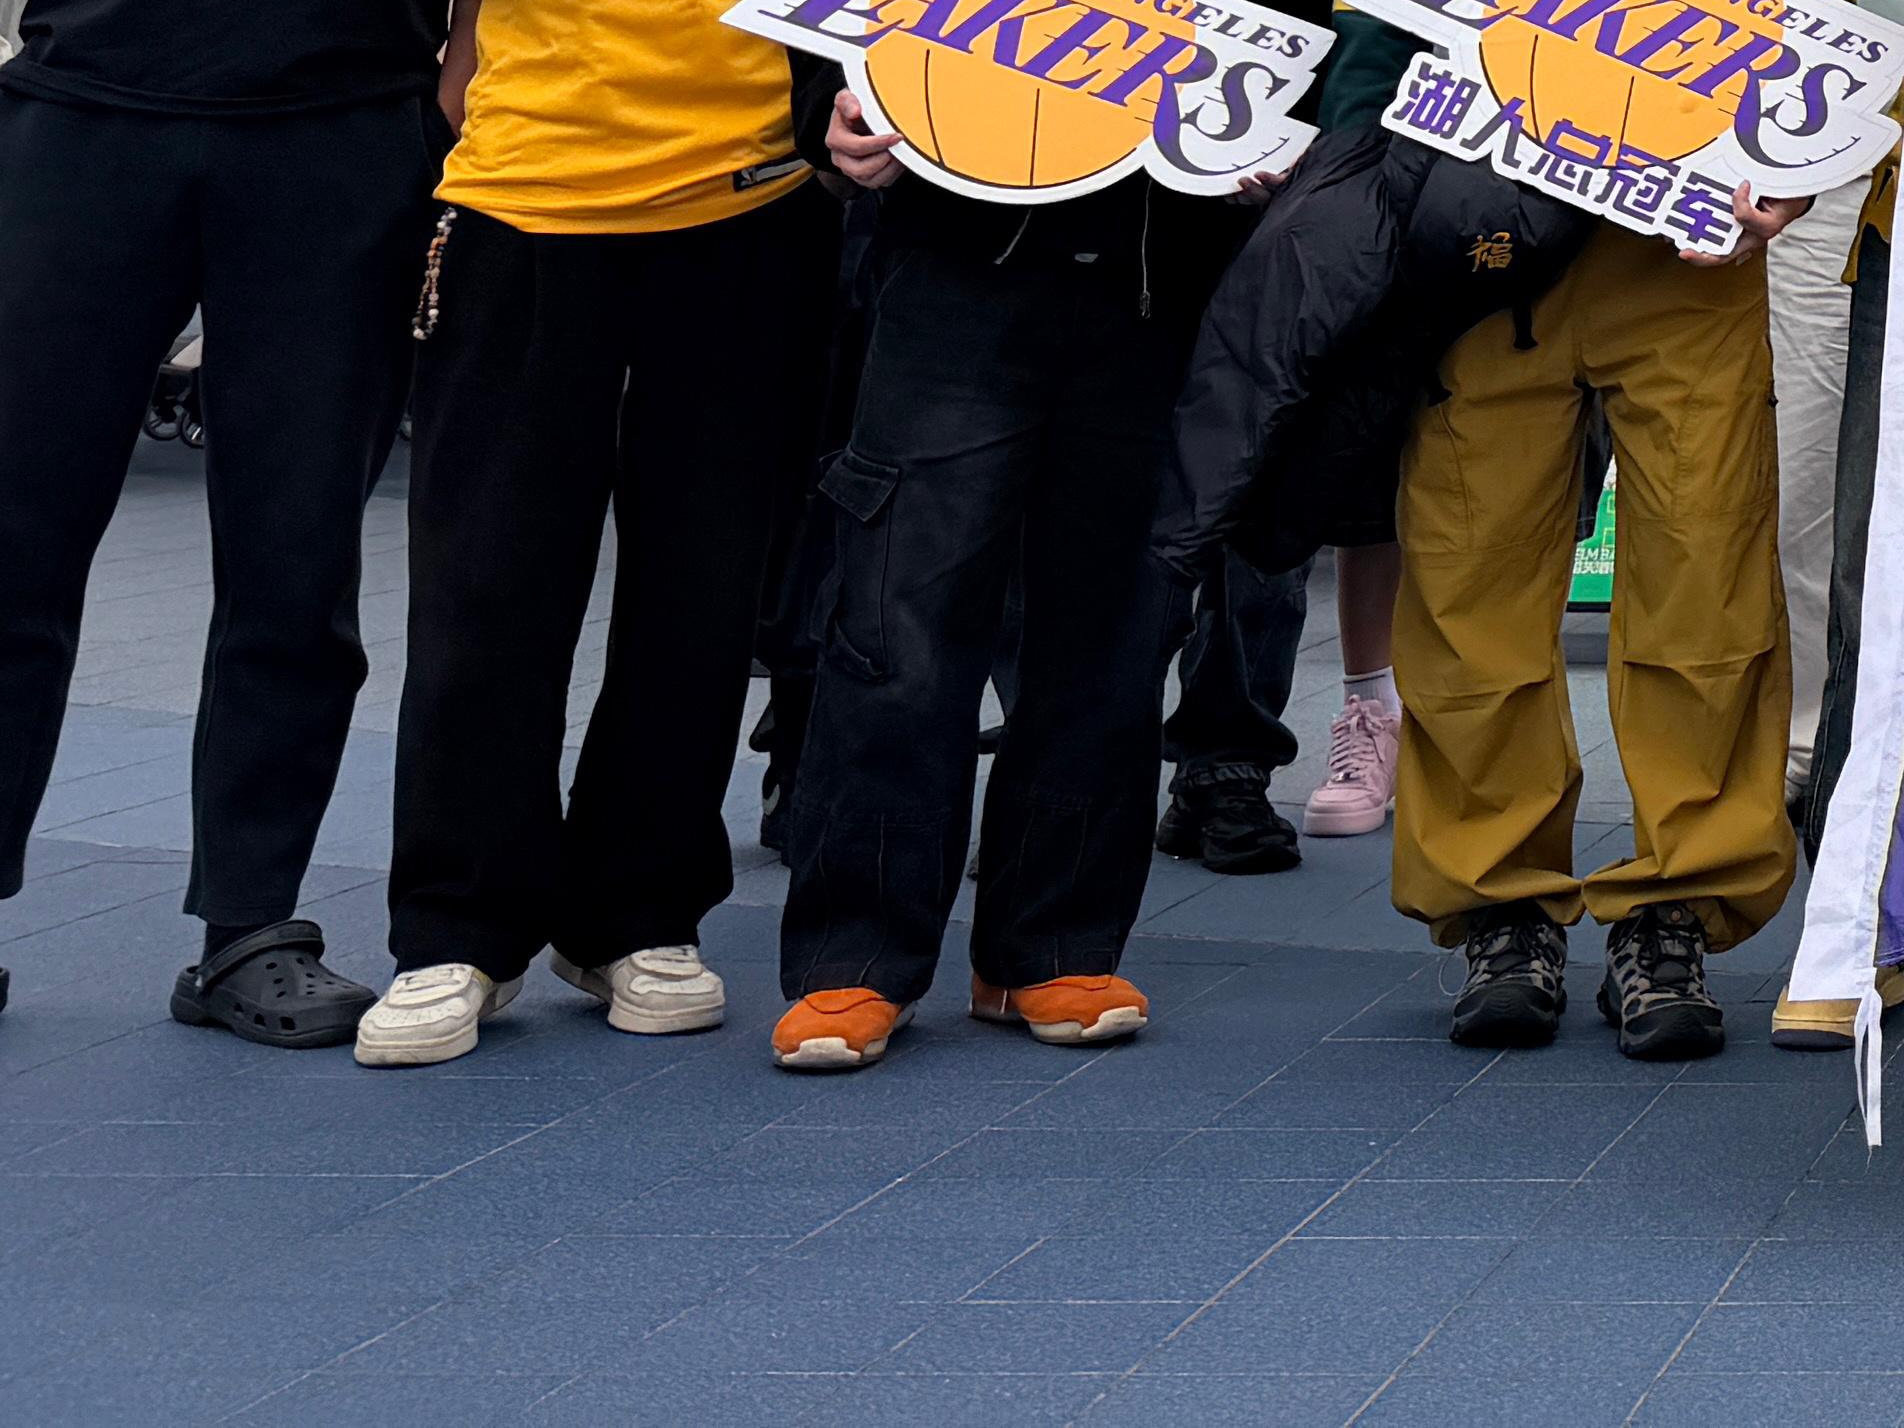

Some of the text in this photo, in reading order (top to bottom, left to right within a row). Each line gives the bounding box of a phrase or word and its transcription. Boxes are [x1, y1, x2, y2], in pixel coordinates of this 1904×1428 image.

[1391, 59, 1738, 249] 湖人总冠军
[1471, 231, 1515, 273] 福
[1574, 547, 1599, 561] ELM
